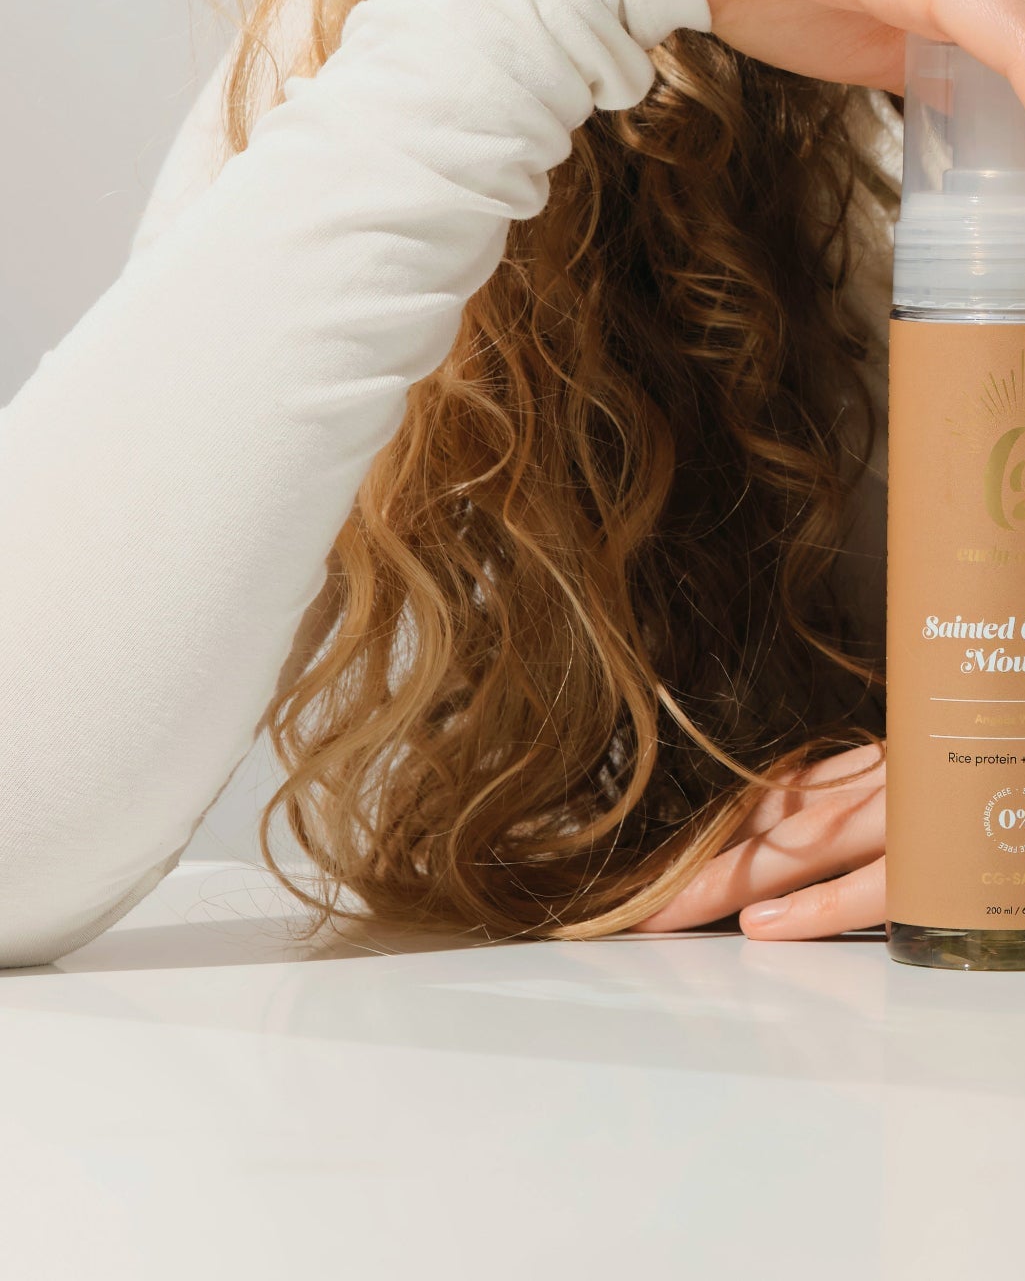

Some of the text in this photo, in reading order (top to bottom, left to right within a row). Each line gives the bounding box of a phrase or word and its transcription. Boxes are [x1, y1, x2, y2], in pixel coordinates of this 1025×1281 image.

[922, 615, 1015, 640] Sainted
[948, 752, 972, 763] Rice
[975, 753, 1017, 766] protein
[983, 787, 1012, 837] PARABEN FREE
[998, 841, 1018, 854] FREE
[986, 906, 1002, 915] 200
[1004, 905, 1013, 914] ml
